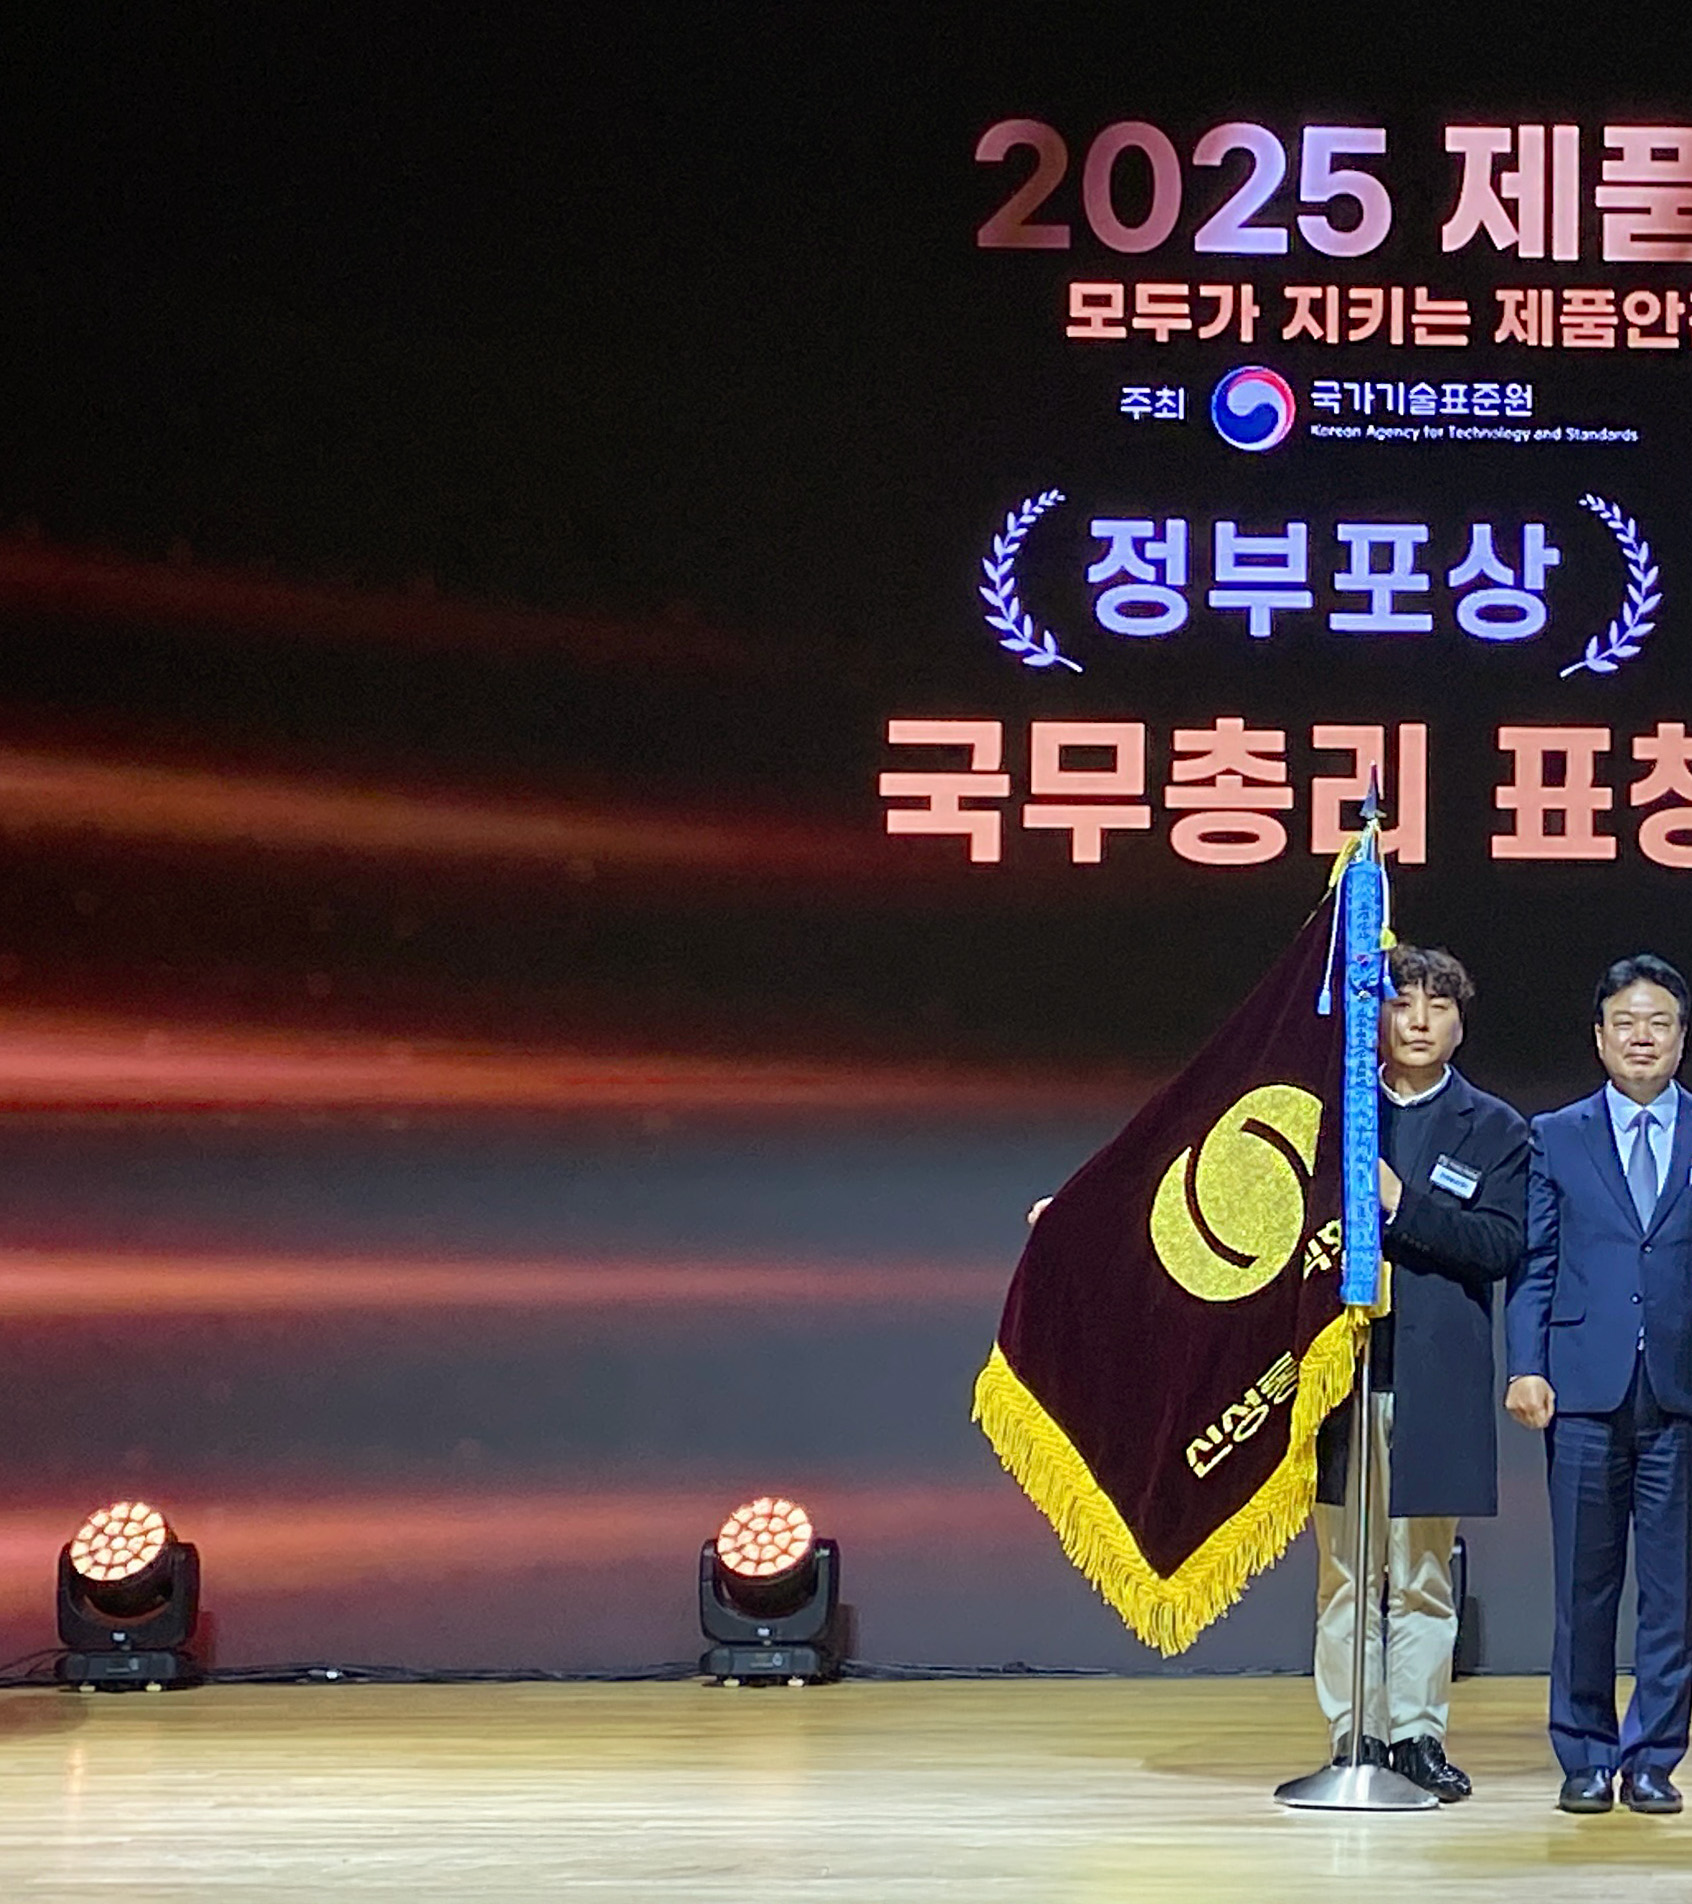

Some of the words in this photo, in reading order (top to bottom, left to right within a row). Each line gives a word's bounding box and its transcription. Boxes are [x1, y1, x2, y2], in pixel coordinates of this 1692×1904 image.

[974, 118, 1392, 257] 2025
[1065, 282, 1261, 343] 모두가
[1282, 285, 1472, 347] 지키는
[1119, 384, 1186, 420] 주최
[1310, 381, 1534, 418] 국가기술표준원
[1310, 424, 1362, 438] Korean
[1365, 424, 1421, 441] Agency
[1423, 424, 1444, 439] for
[1448, 424, 1532, 443] Technology
[1533, 426, 1562, 441] and
[1566, 426, 1639, 442] Standards
[1086, 518, 1562, 642] 정부포상
[878, 717, 1428, 866] 국무총리
[1186, 1350, 1299, 1479] 신성통
